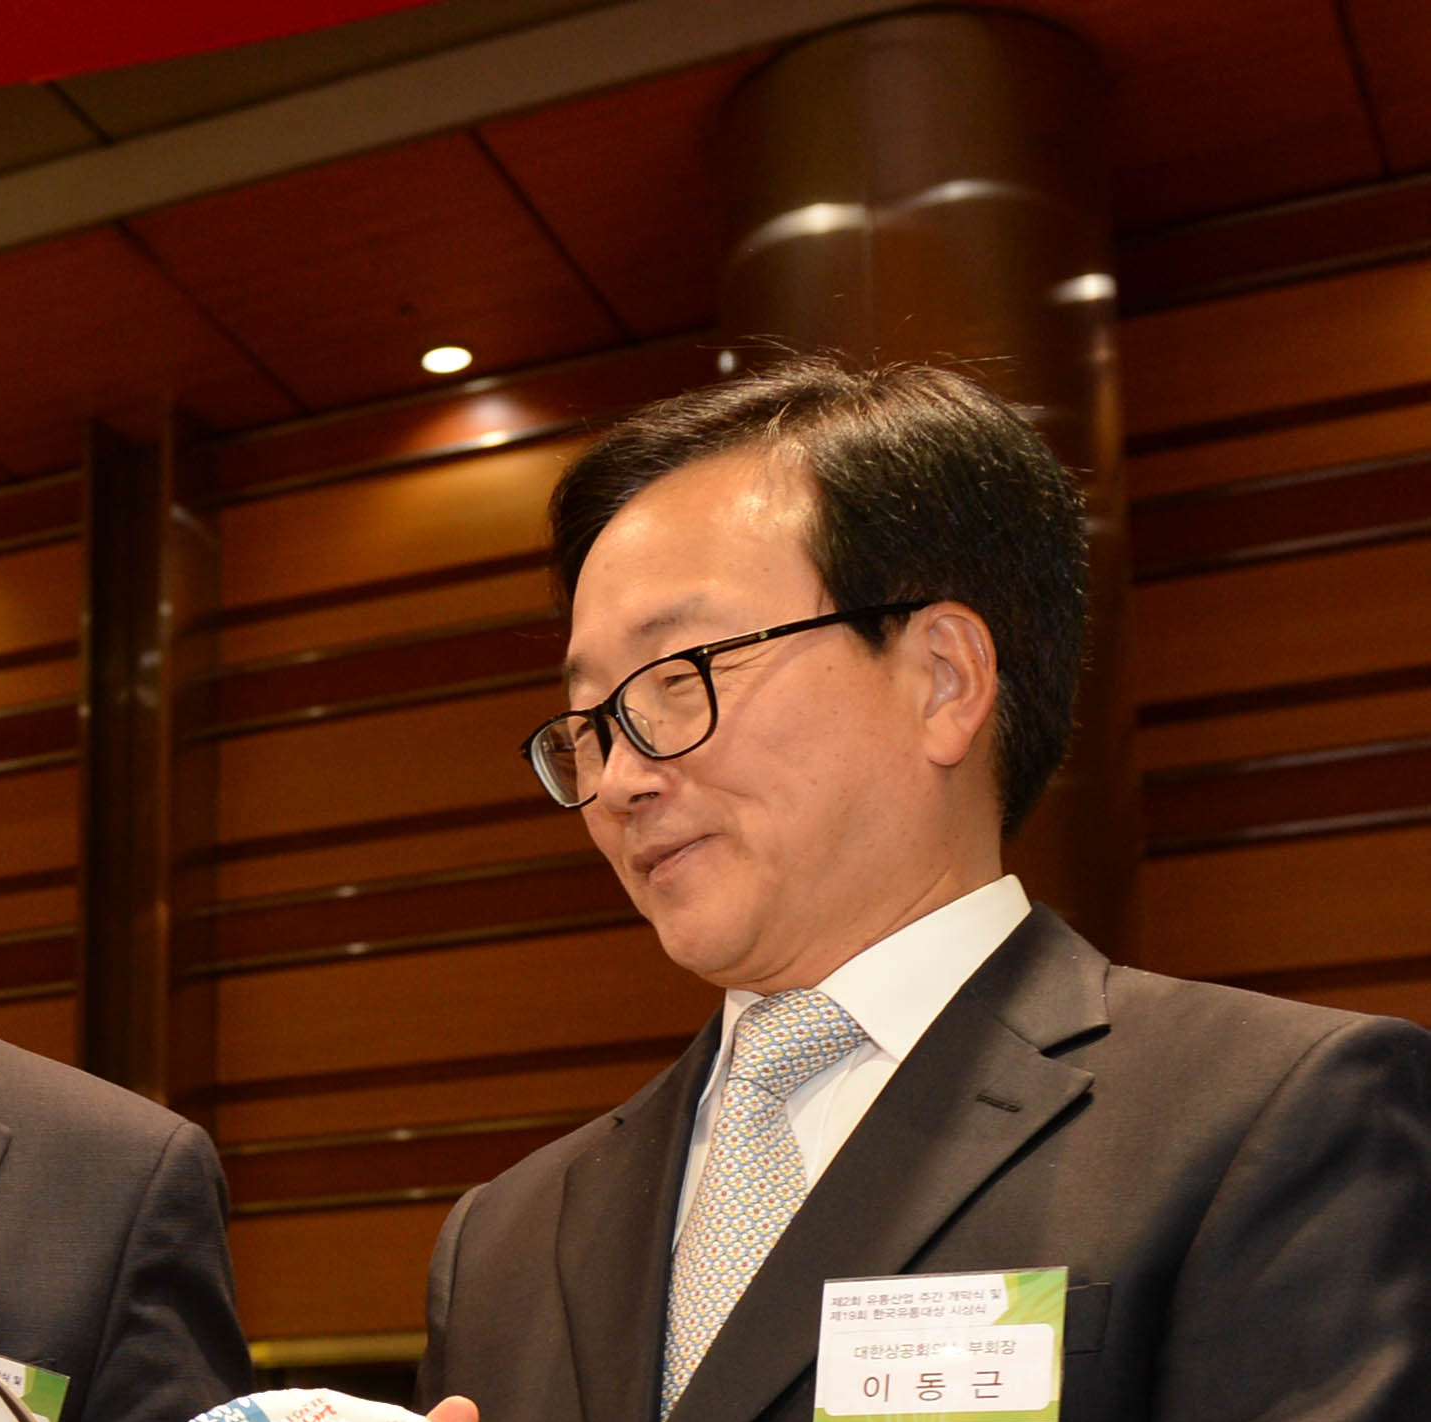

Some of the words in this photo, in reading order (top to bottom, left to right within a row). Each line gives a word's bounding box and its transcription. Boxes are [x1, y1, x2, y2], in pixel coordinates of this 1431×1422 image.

[866, 1291, 914, 1307] 유통산업
[873, 1305, 946, 1321] 한국유통대상
[968, 1339, 1017, 1356] 부회장
